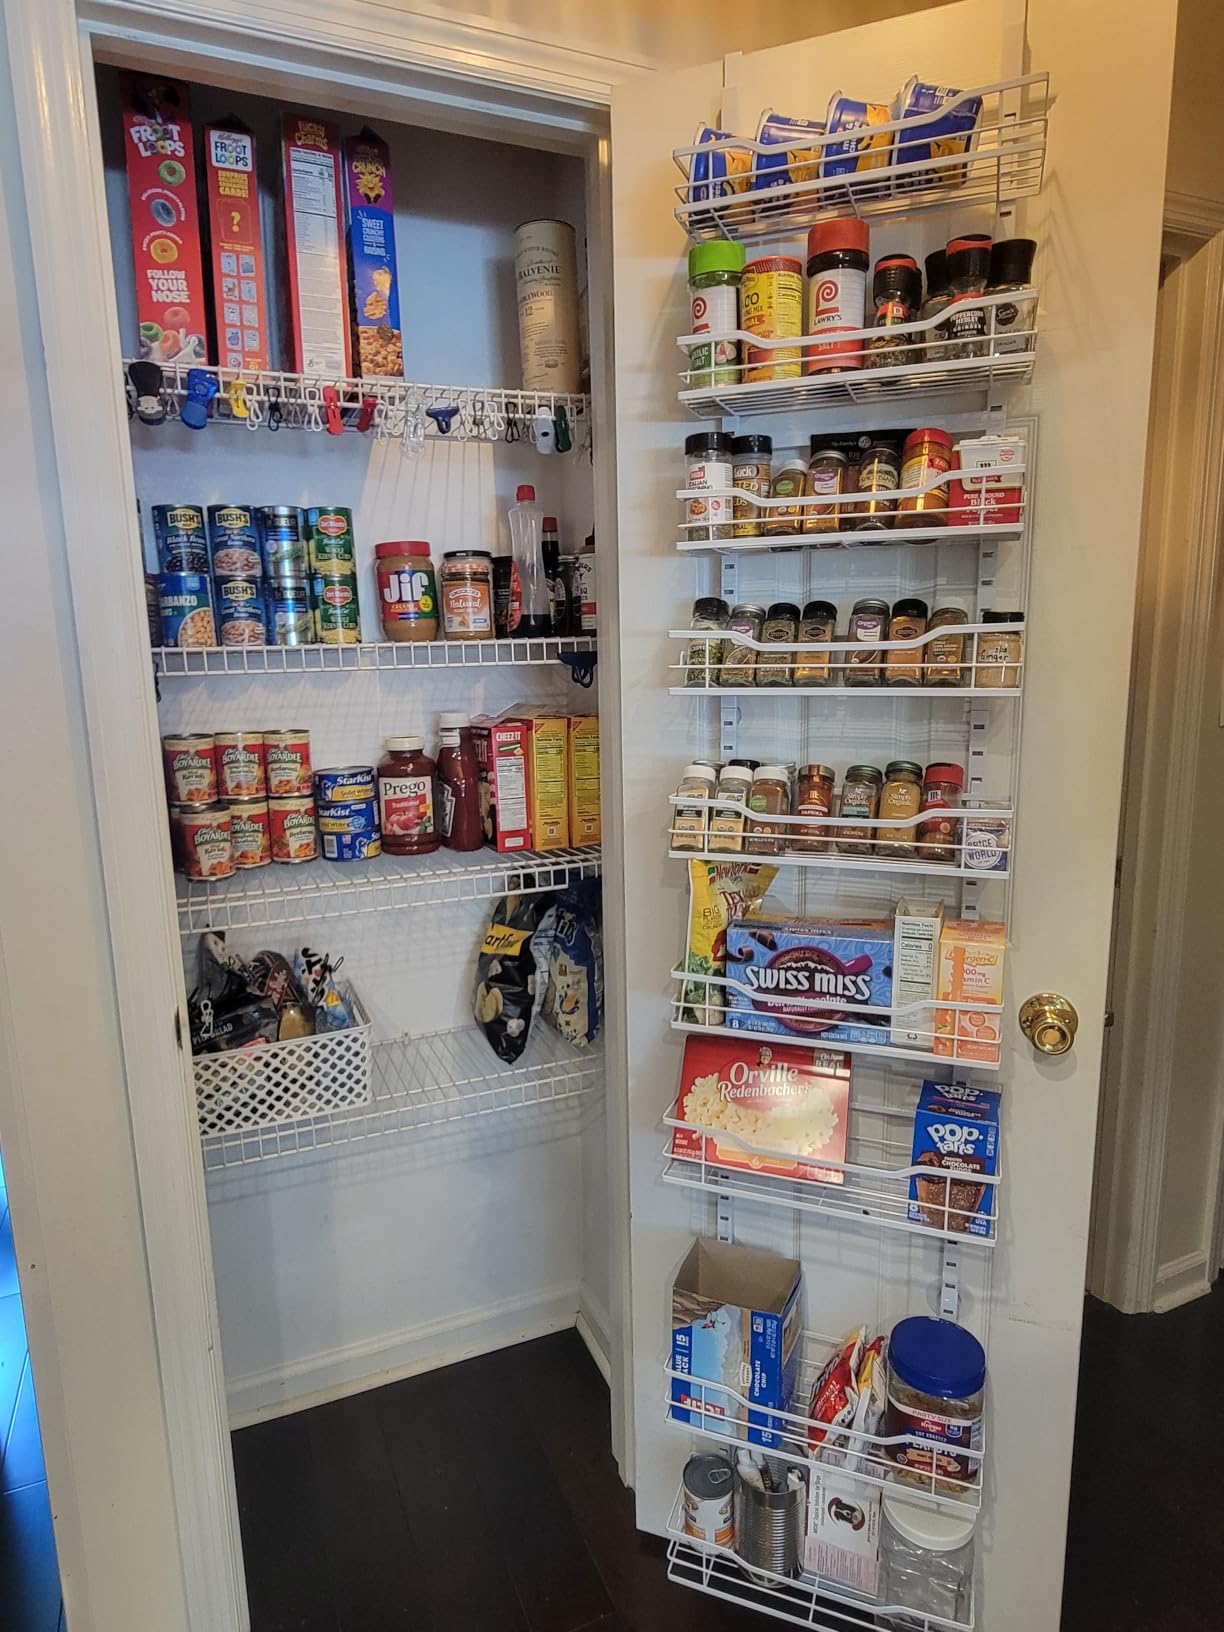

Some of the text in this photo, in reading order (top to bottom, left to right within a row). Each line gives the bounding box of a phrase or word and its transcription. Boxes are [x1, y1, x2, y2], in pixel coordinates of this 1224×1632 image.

[130, 124, 181, 144] FROOT
[138, 140, 185, 157] LOOPS
[215, 141, 247, 155] FROOT
[216, 152, 248, 167] LOOPS
[352, 160, 386, 177] CRUNCH
[362, 218, 384, 230] SWEET
[147, 270, 185, 279] FOLLOW
[149, 279, 187, 291] YOUR
[151, 290, 191, 303] NOSE
[524, 305, 534, 317] 12
[949, 310, 984, 322] PEPPERCORN
[813, 313, 843, 326] LAWRY'S
[955, 316, 979, 324] MEDLEY
[953, 324, 982, 332] GRINDER
[970, 498, 997, 507] Blck
[169, 513, 201, 525] BUSH'S
[217, 513, 249, 524] BUSH'S
[167, 536, 188, 544] Black
[223, 584, 256, 596] BUSH'S
[383, 571, 429, 603] Jif
[450, 598, 482, 609] Natural
[980, 649, 1009, 662] Ginger
[173, 757, 211, 770] BOYARDEE
[222, 752, 259, 764] BOYARDEE
[336, 773, 373, 786] StarKist
[383, 781, 426, 798] Prego
[847, 793, 867, 802] Simply
[888, 798, 912, 806] Organic
[890, 793, 911, 801] Simply
[391, 799, 420, 809] Traditional
[318, 807, 351, 817] StarKist
[231, 821, 264, 832] OYARDEE
[968, 850, 997, 861] WORLD
[703, 905, 720, 917] BIG
[928, 942, 933, 950] 0
[729, 1062, 799, 1085] Orville
[941, 1159, 981, 1170] CHOCOLATE
[676, 1334, 686, 1346] 15
[912, 1409, 953, 1424] PARTY SIZE
[920, 1421, 942, 1432] Kroger
[762, 1431, 772, 1442] 15
